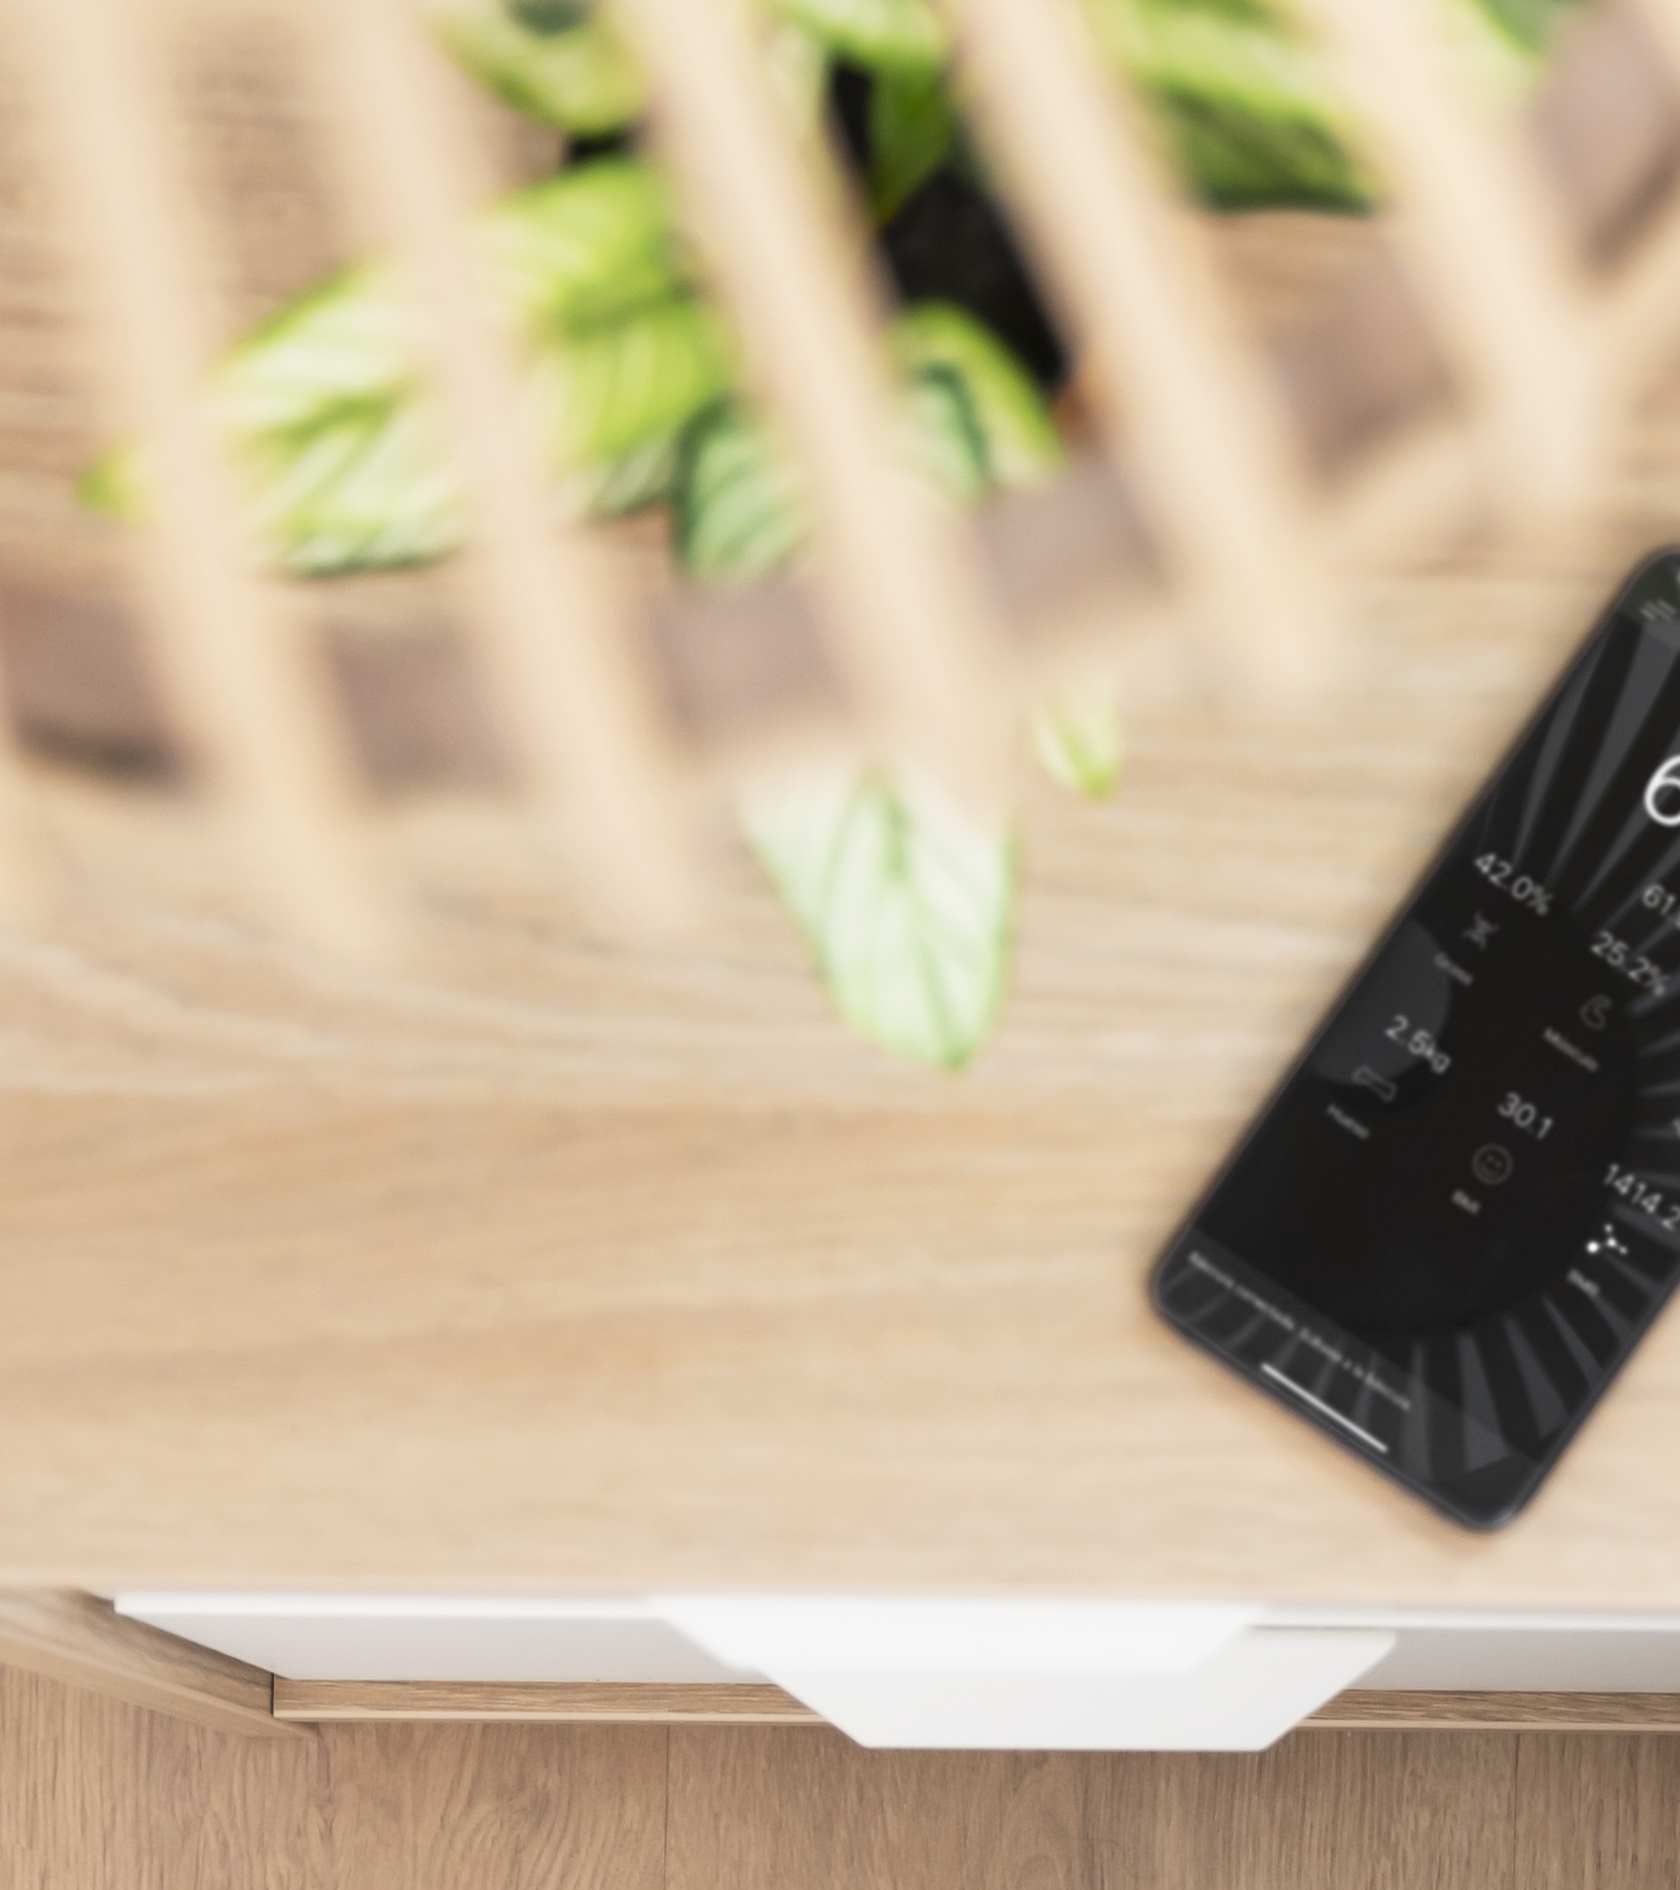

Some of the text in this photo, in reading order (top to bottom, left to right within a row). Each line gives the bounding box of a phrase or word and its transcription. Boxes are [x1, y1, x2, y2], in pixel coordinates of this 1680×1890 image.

[1474, 852, 1553, 917] 42.0%
[1589, 930, 1669, 997] 25.2%
[1496, 1091, 1554, 1140] 30.1
